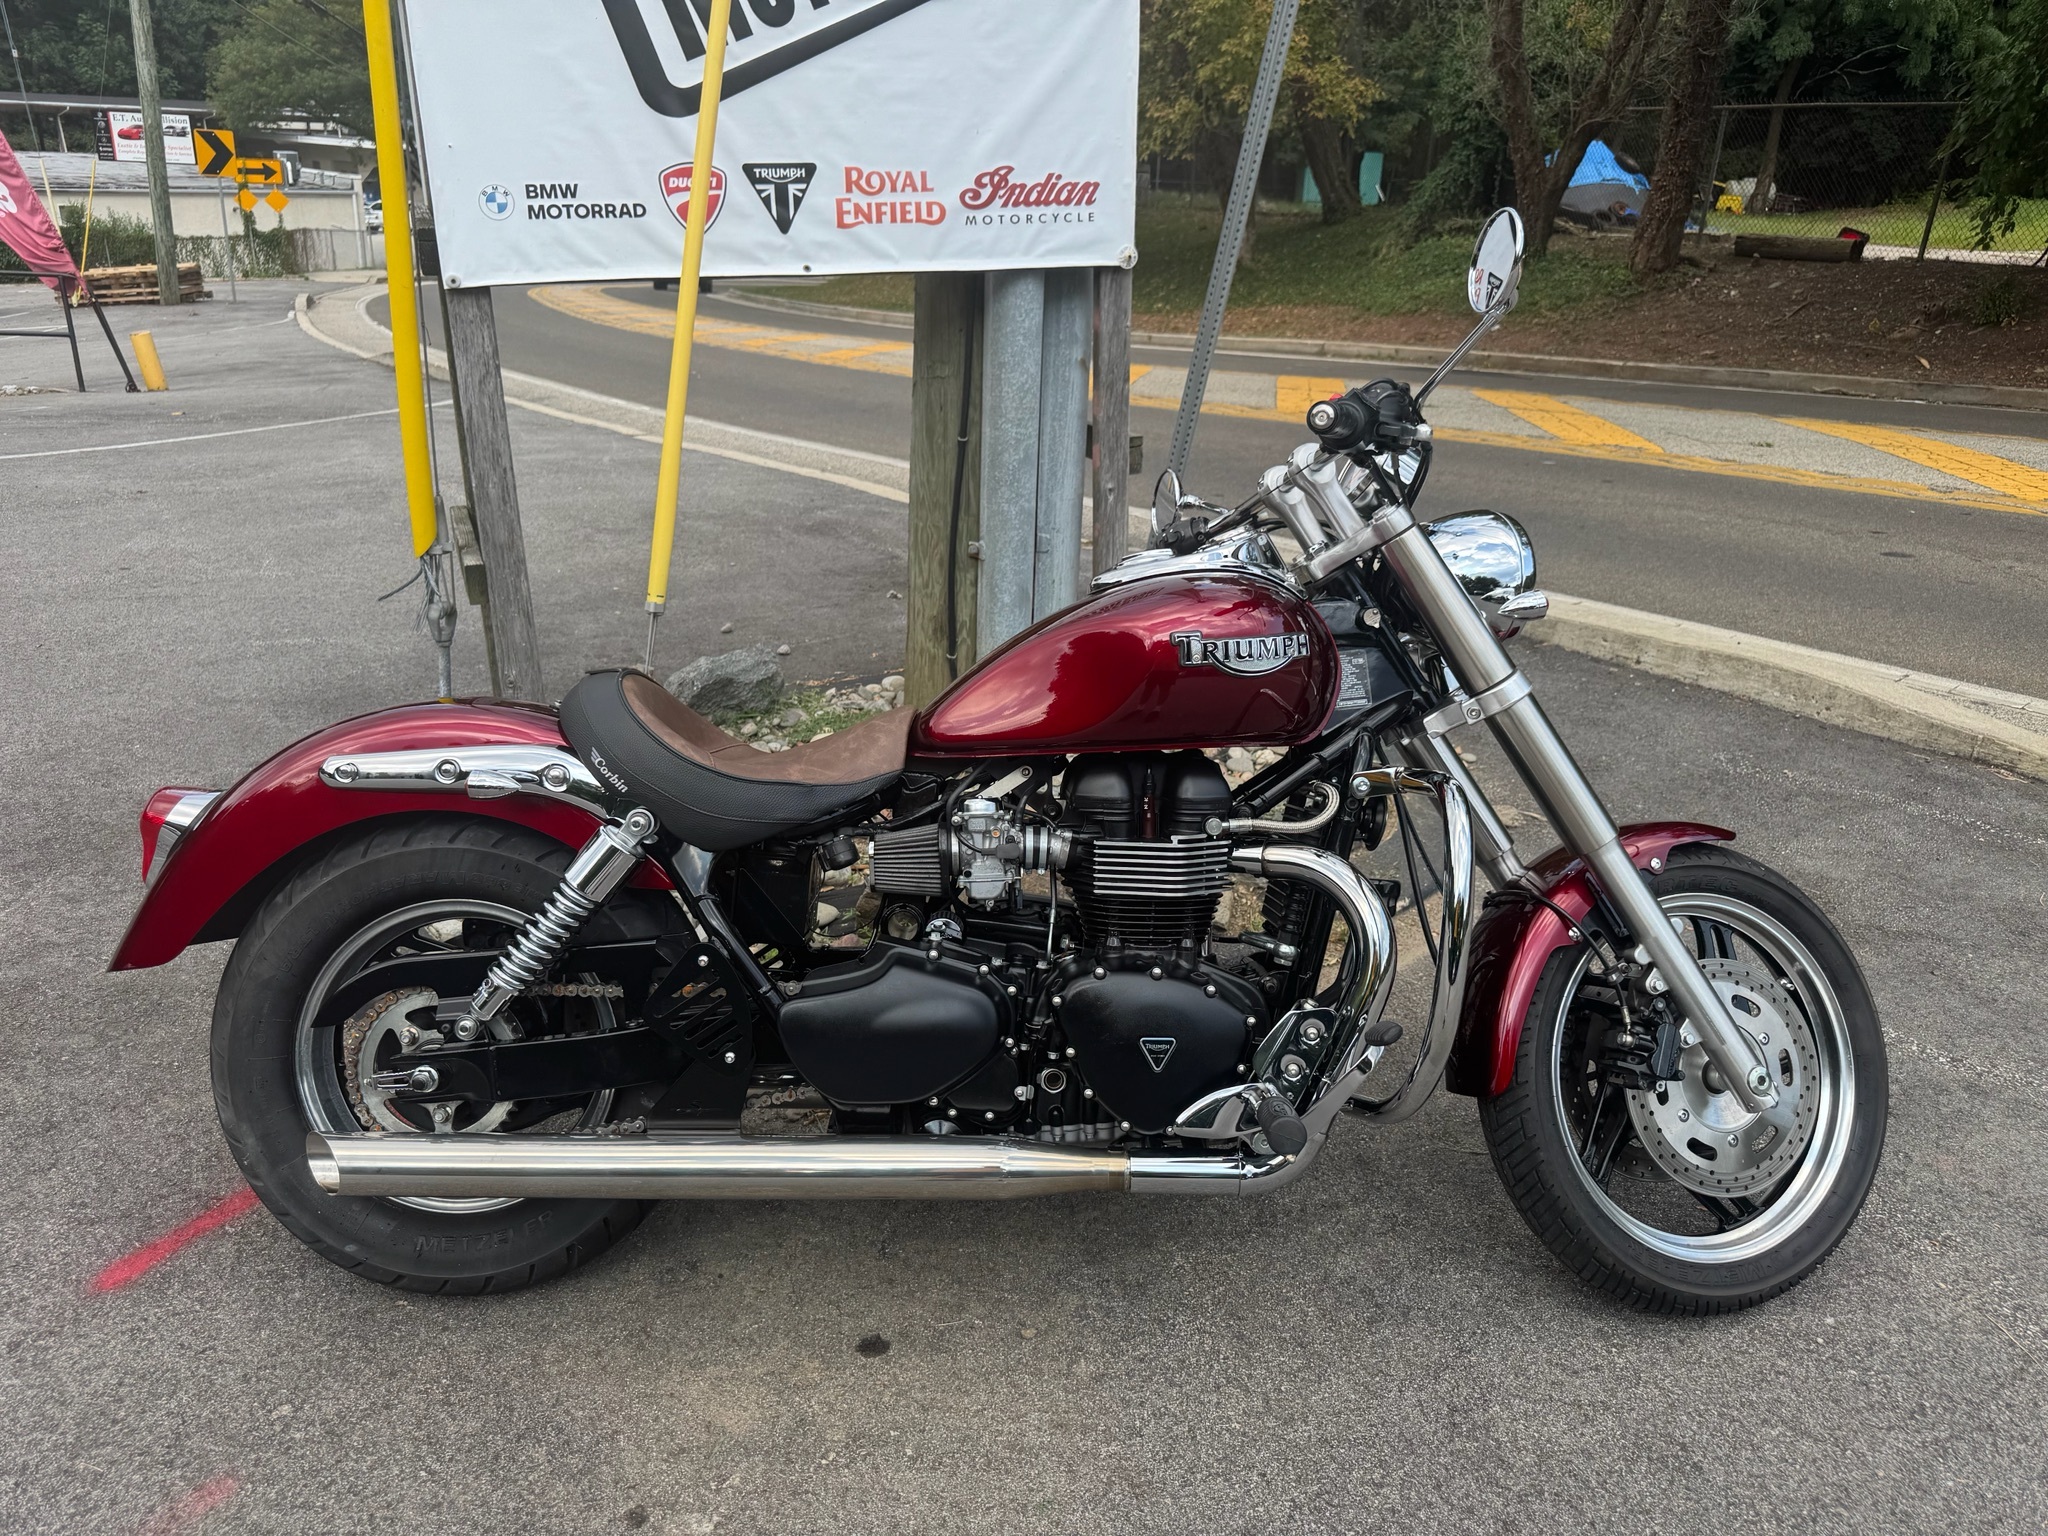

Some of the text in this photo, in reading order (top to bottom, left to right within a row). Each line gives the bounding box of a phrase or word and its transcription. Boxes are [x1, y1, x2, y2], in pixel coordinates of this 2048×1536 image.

[162, 115, 188, 124] llision
[753, 167, 806, 180] TRIUMPH
[844, 166, 934, 196] ROYAL
[525, 183, 578, 200] BMW
[959, 165, 1101, 211] Indian
[527, 203, 647, 220] MOTORRAD
[835, 198, 947, 230] ENFIELD
[965, 212, 1096, 226] MOTORCYCLE
[1174, 632, 1310, 666] TRIUMPH
[594, 757, 629, 793] Corbin
